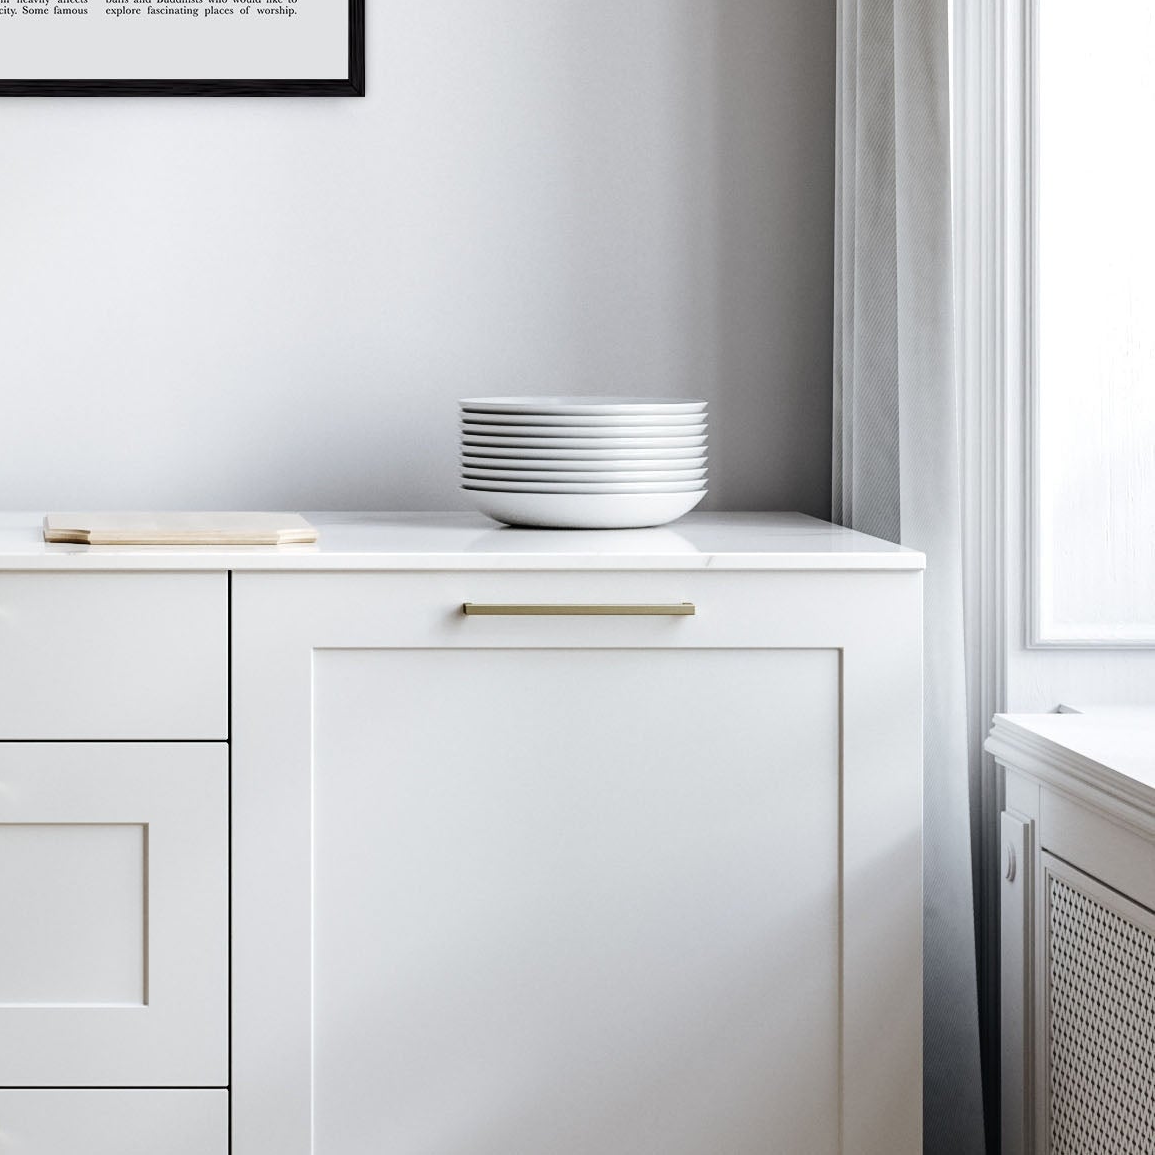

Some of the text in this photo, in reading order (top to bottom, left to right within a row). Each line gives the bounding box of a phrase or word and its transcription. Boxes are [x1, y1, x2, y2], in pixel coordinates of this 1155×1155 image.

[105, 6, 297, 17] explore fascinating places of worship.
